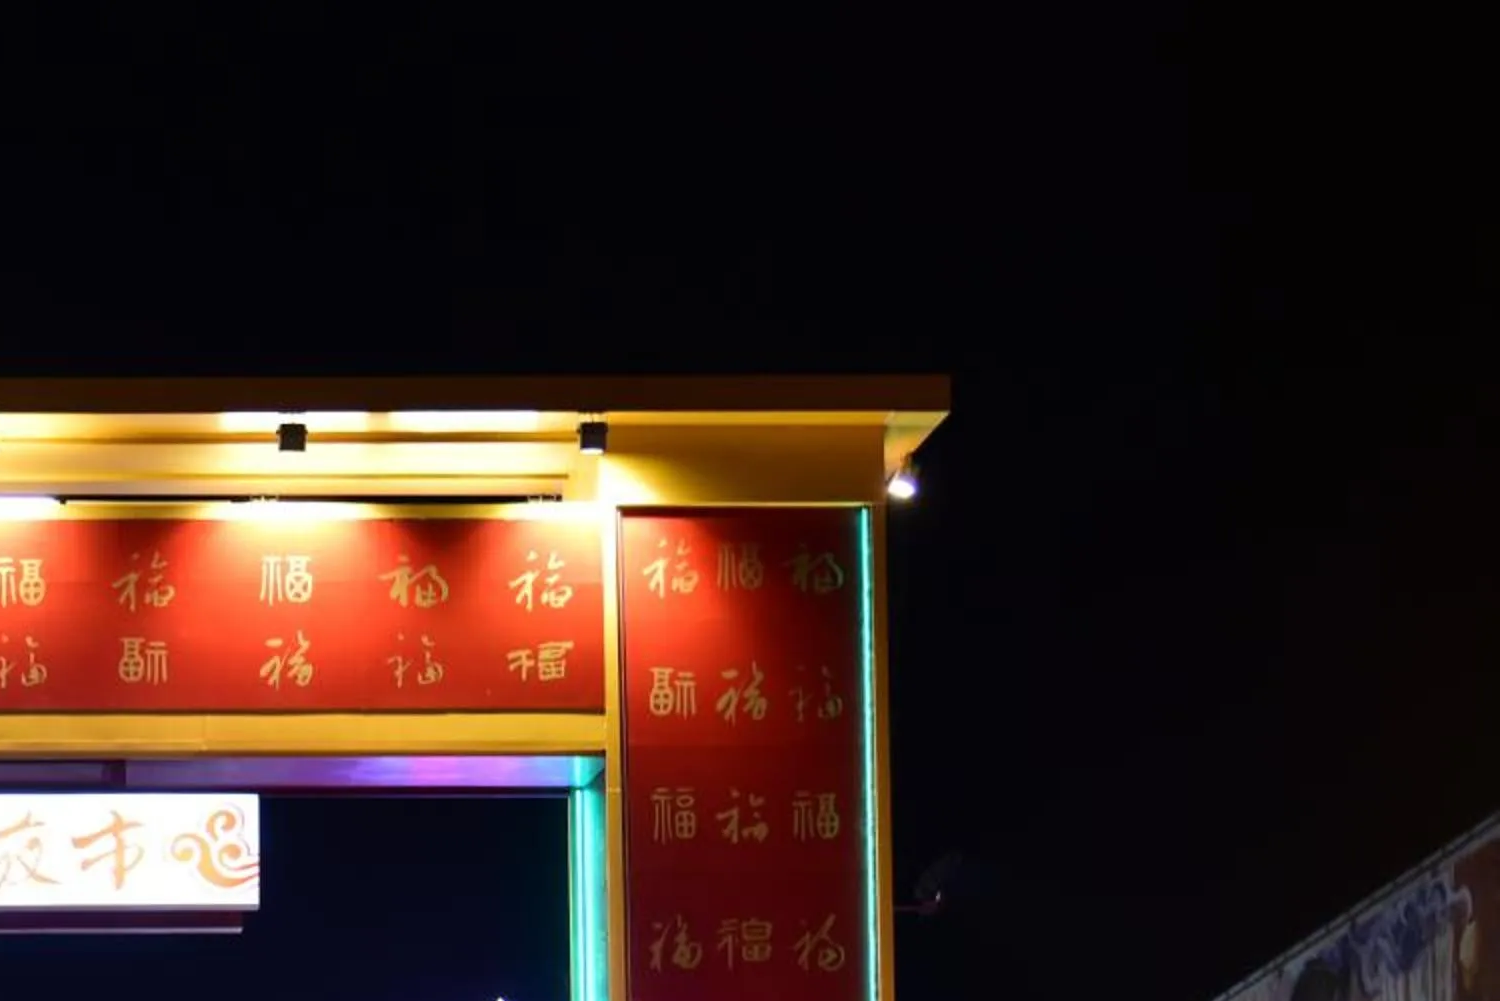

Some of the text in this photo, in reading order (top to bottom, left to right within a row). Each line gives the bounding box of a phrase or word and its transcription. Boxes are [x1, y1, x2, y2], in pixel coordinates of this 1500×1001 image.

[112, 552, 175, 612] 福
[259, 557, 312, 606] 福
[380, 555, 448, 608] 福
[508, 551, 572, 612] 福
[643, 539, 844, 599] 福 福 福
[118, 637, 167, 685] 福
[260, 630, 313, 689] 福
[388, 634, 444, 688] 福
[507, 641, 574, 681] 福
[650, 661, 842, 724] 福 福 福
[651, 788, 839, 844] 福 福 福
[650, 914, 845, 971] 福 福 福
